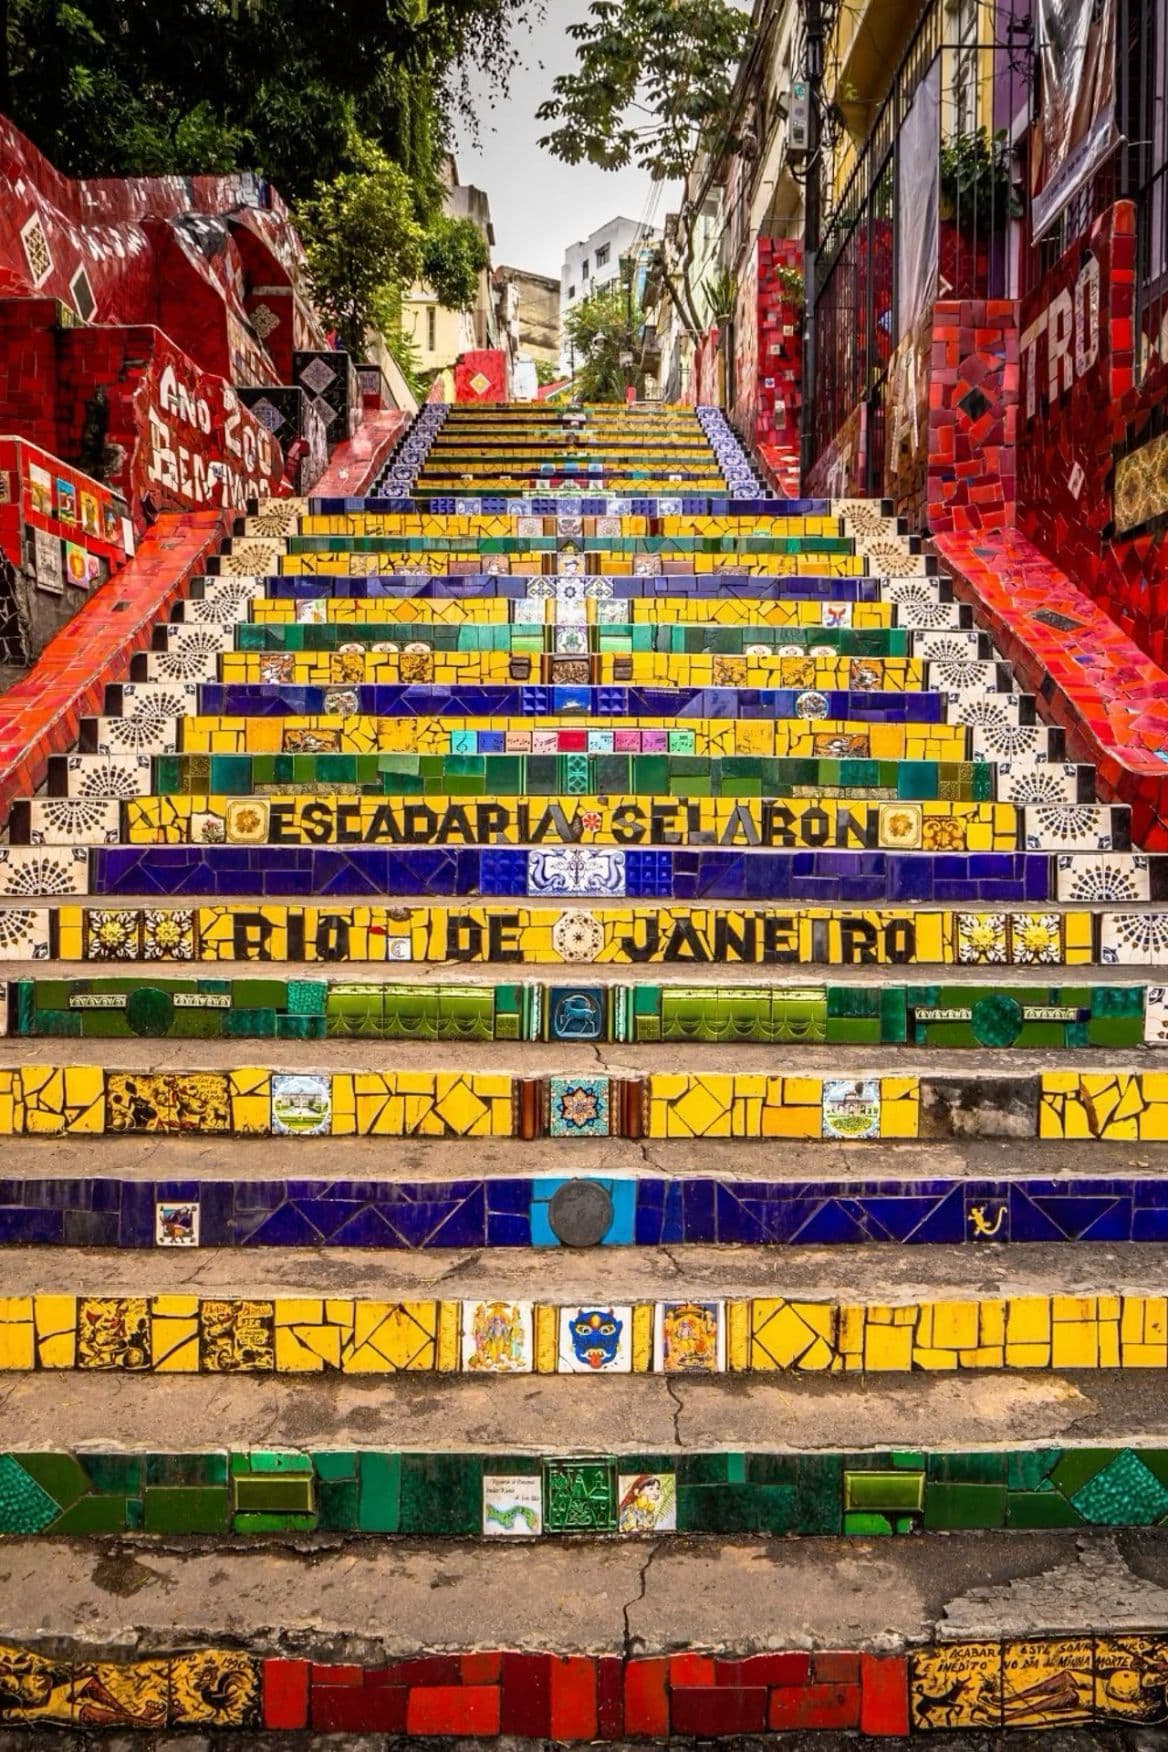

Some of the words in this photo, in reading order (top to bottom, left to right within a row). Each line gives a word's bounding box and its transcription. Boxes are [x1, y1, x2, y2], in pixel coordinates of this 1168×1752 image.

[233, 913, 350, 961] RIO
[446, 914, 522, 961] DE
[621, 915, 916, 963] JANEIRO
